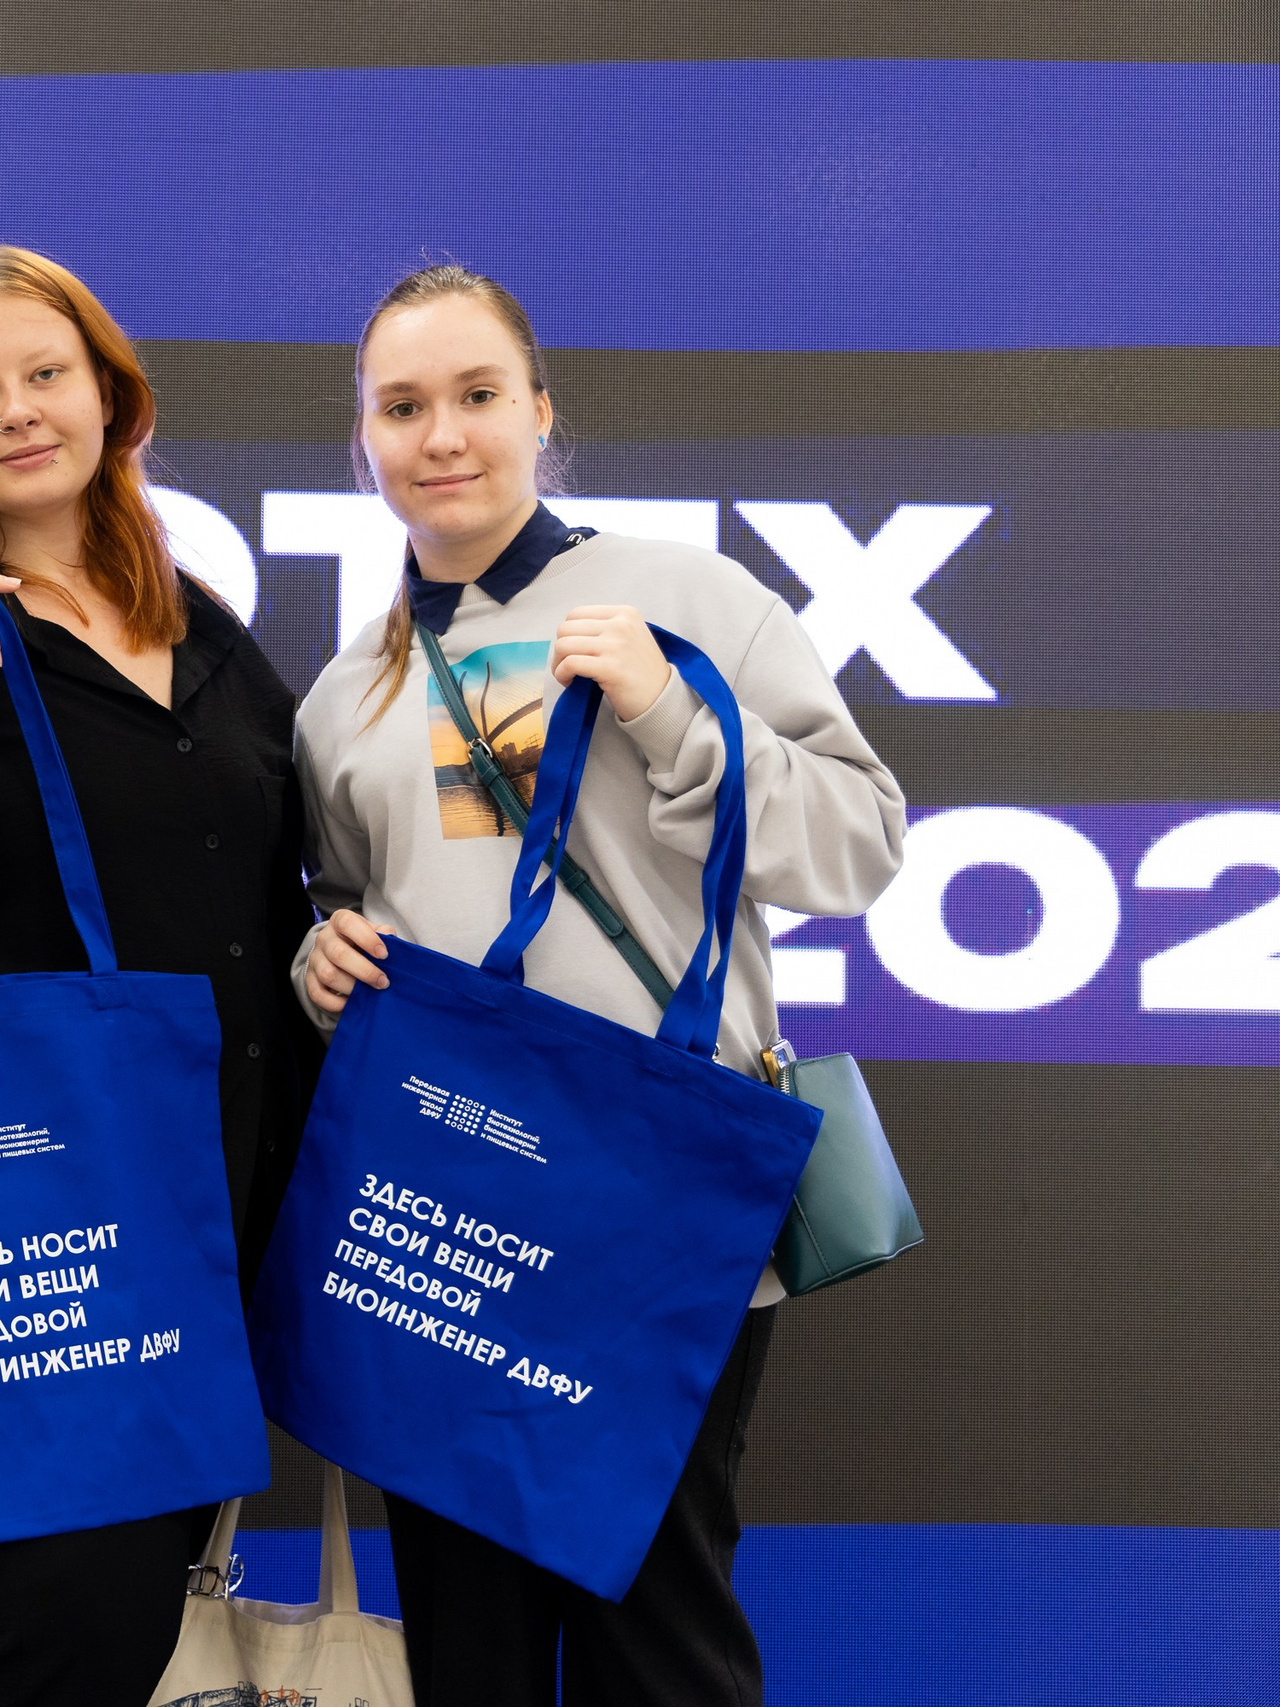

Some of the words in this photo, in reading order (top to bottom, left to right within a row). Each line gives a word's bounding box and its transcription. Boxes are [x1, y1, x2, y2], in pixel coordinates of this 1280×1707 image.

[401, 1082, 448, 1105] инженерная
[409, 1075, 450, 1098] Передовая
[419, 1098, 444, 1113] школа
[419, 1106, 442, 1120] ДВФУ
[489, 1109, 523, 1127] Институт
[483, 1124, 537, 1151] биоинженерии
[486, 1116, 541, 1145] биотехнологий,
[359, 1173, 447, 1227] ЗДЕСЬ
[453, 1213, 554, 1272] НОСИТ
[21, 1223, 118, 1261] НОСИТ
[348, 1207, 430, 1257] СВОИ
[433, 1241, 515, 1293] ВЕЩИ
[19, 1264, 99, 1299] ВЕЩИ
[334, 1238, 482, 1317] ПЕРЕДОВОЙ
[140, 1328, 180, 1363] ДВФУ
[322, 1271, 507, 1366] БИОИНЖЕНЕР
[506, 1356, 593, 1404] ДВФУ
